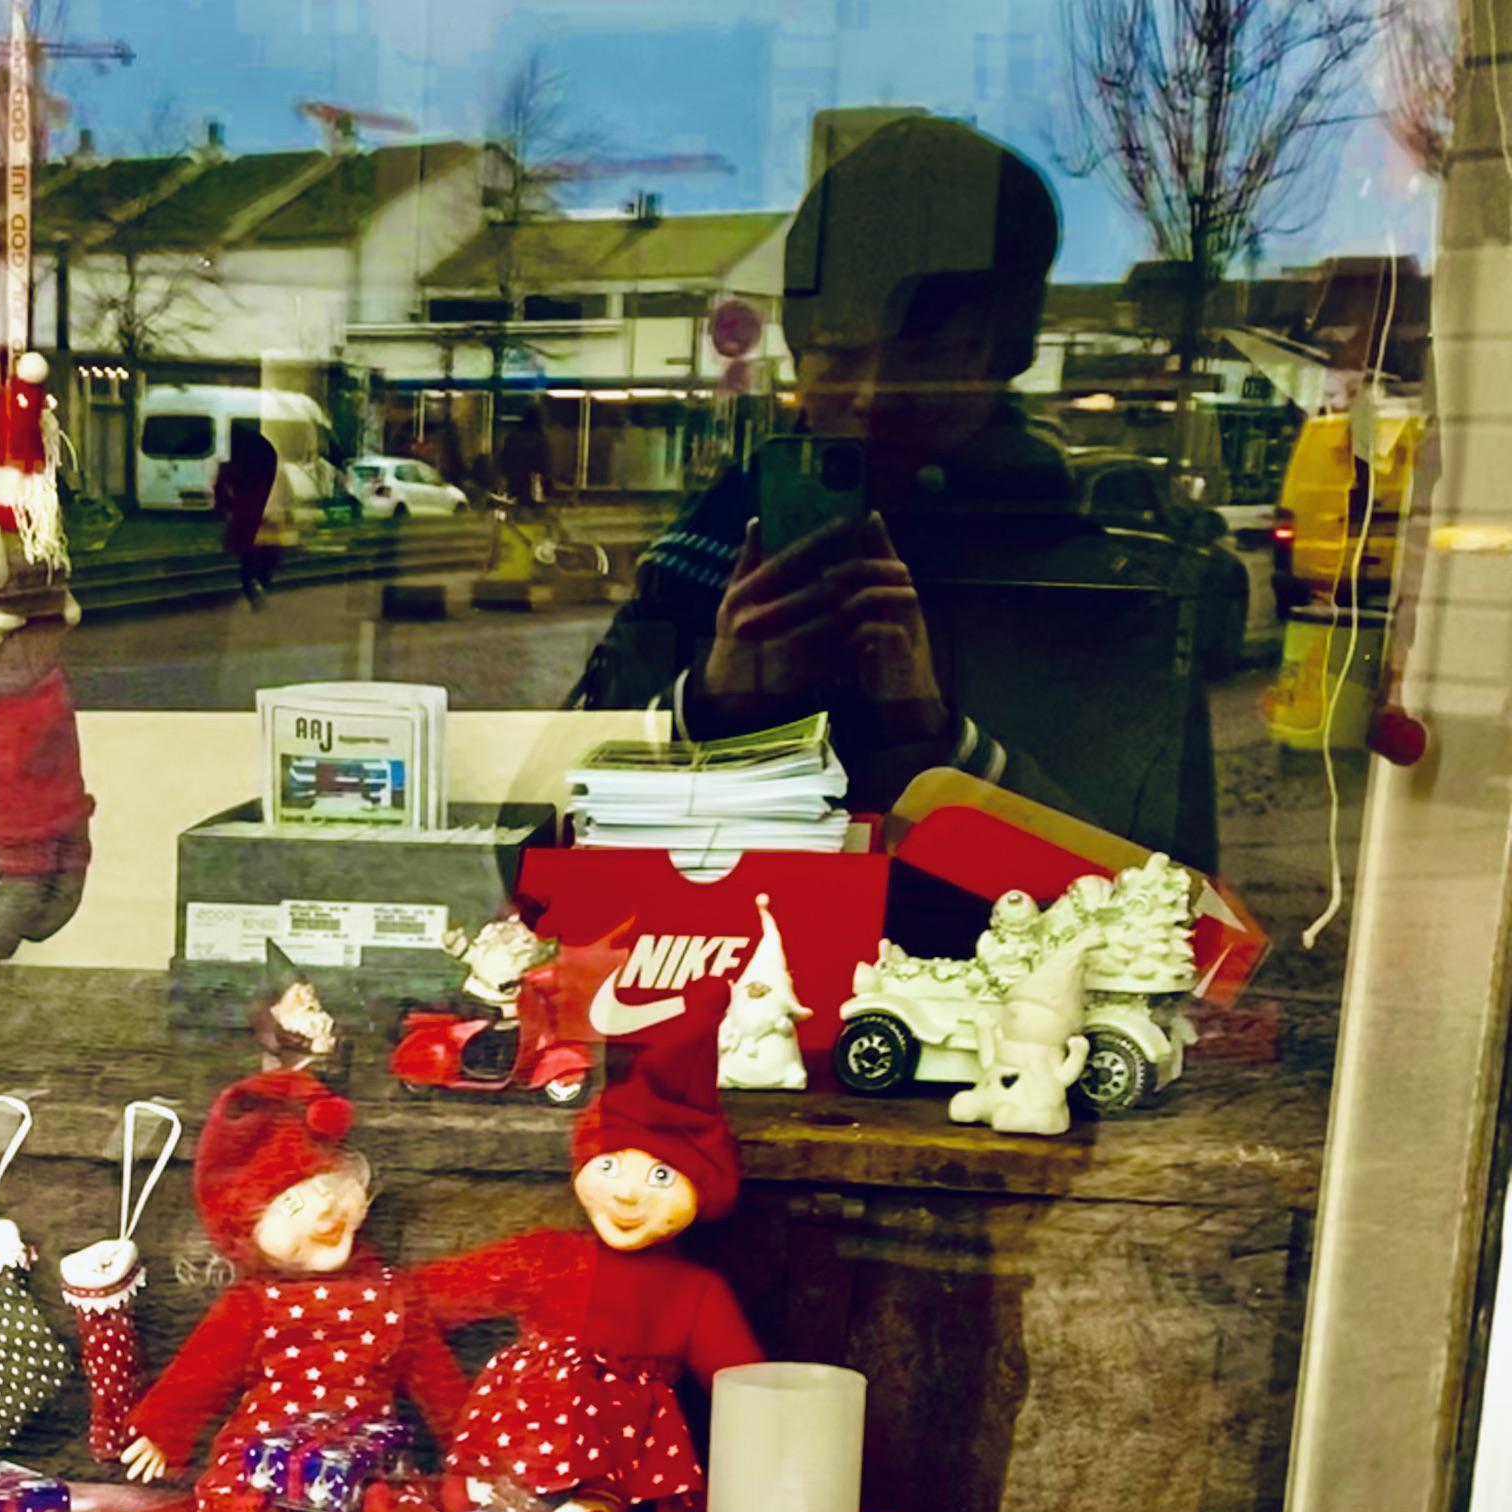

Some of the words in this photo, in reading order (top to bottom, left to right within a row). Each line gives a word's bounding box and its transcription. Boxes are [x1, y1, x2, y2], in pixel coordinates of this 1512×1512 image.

[11, 88, 27, 143] GOD
[11, 214, 27, 268] GOD
[616, 934, 751, 990] NIKE
